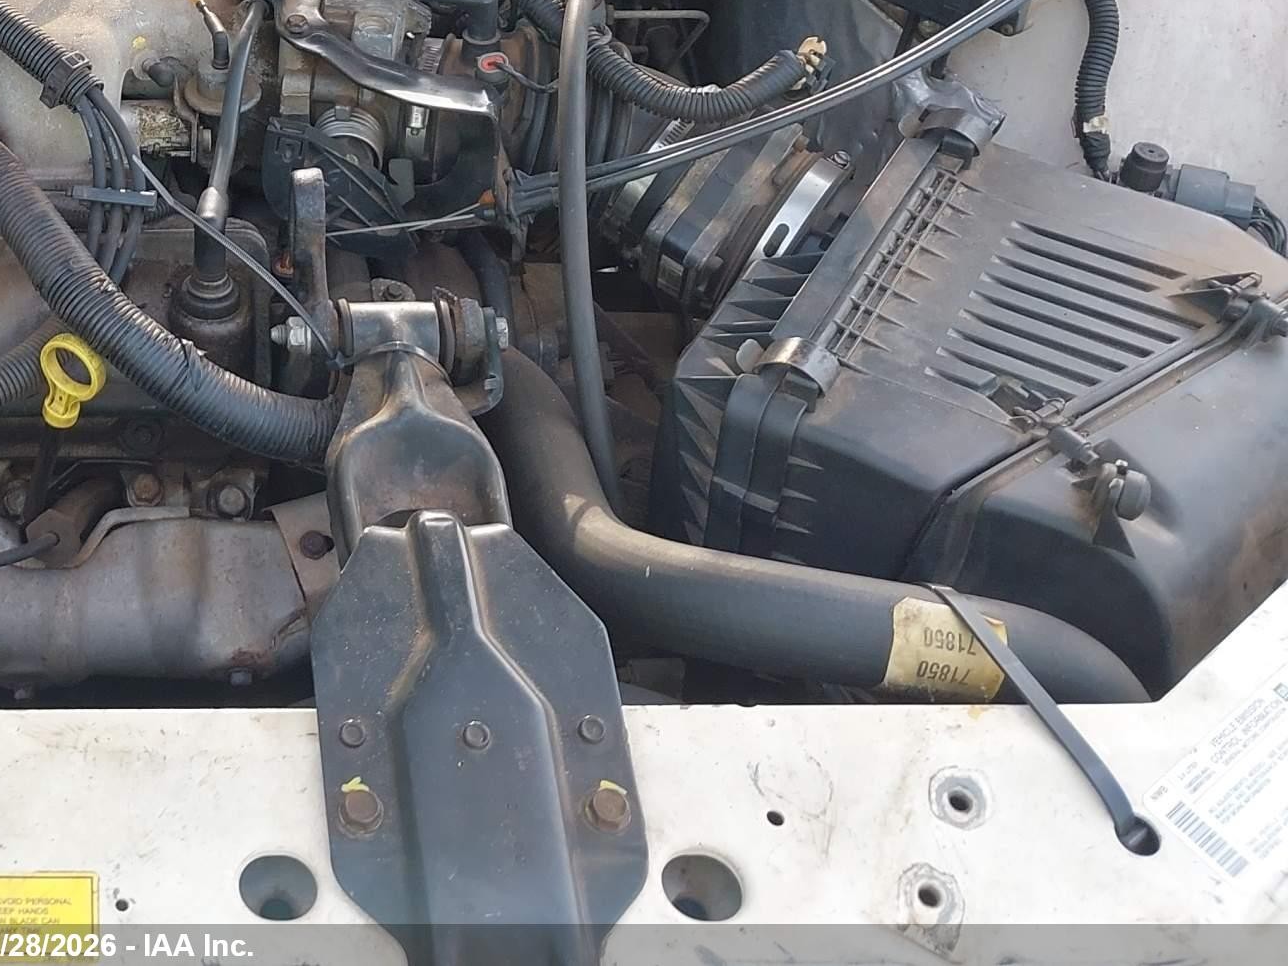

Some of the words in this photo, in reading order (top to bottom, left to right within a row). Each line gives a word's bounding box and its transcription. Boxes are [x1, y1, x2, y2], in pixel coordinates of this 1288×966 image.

[923, 626, 977, 656] 71850
[916, 660, 971, 686] 71850
[1210, 737, 1243, 765] CONTROL
[18, 907, 49, 915] HANDS
[25, 897, 72, 905] PERSONAL
